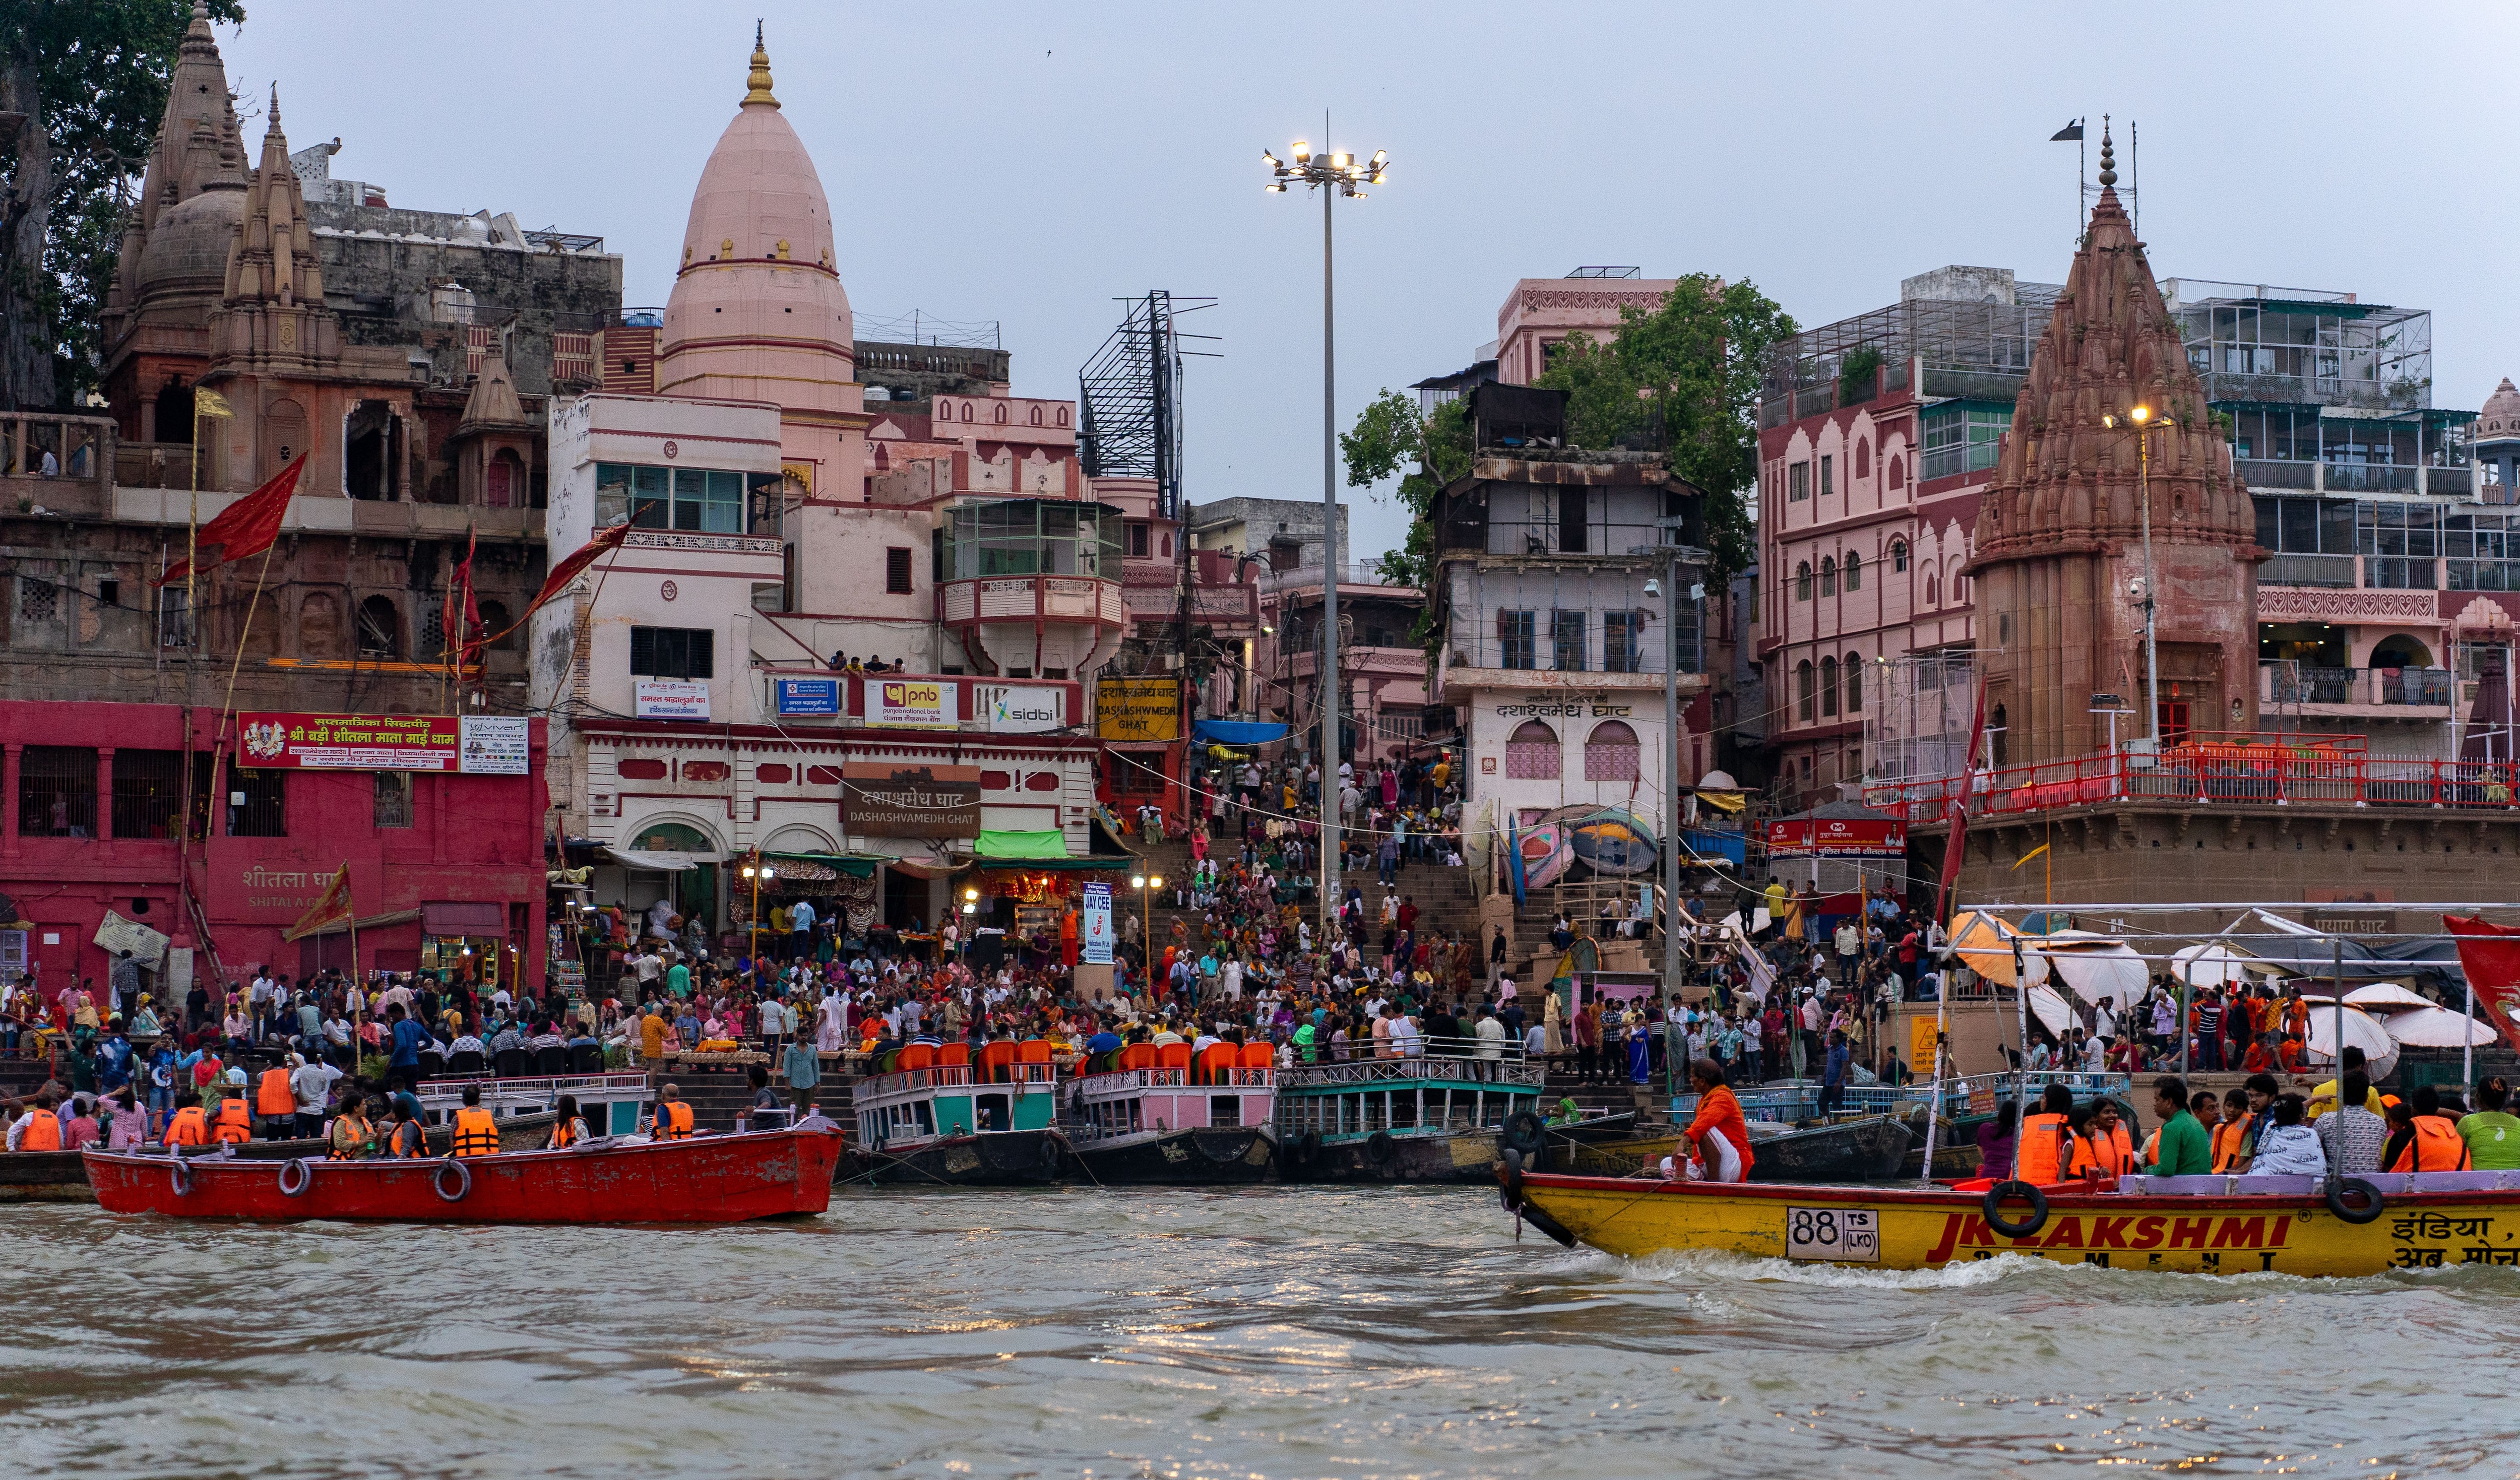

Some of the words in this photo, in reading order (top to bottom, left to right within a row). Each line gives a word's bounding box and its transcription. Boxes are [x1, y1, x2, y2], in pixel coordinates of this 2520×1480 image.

[908, 687, 937, 705] pnb
[1157, 687, 1177, 698] घाट
[664, 695, 696, 705] श्रद्धालुओं
[1012, 708, 1053, 721] sidbi
[1098, 705, 1175, 716] DASHASHWMEDH
[1592, 705, 1632, 717] घाट
[314, 717, 381, 726] सप्तमात्रिका
[1118, 719, 1149, 730] GHAT
[290, 726, 304, 741] श्री
[308, 726, 329, 746] बड़ी
[333, 727, 372, 742] शीतला
[375, 732, 403, 743] माता
[406, 729, 428, 747] माई
[431, 734, 455, 744] धाम
[936, 793, 964, 807] घाट
[850, 812, 944, 823] DASHASHVAMEDH
[947, 814, 974, 824] GHAT
[1818, 847, 1840, 857] पुलिस
[1862, 847, 1886, 855] शीतला
[242, 865, 307, 888] शीतला
[312, 873, 337, 887] घा
[248, 896, 303, 908] SHITALA
[1086, 895, 1097, 909] JAY
[1098, 896, 1110, 911] CEE
[2359, 920, 2387, 933] घाट
[1847, 1213, 1868, 1226] TS
[1793, 1210, 1839, 1245] 88
[1846, 1231, 1876, 1257] (LKO)
[1925, 1213, 2001, 1262] JK
[2011, 1215, 2292, 1249] LAKSHMI
[2387, 1248, 2447, 1268] अब
